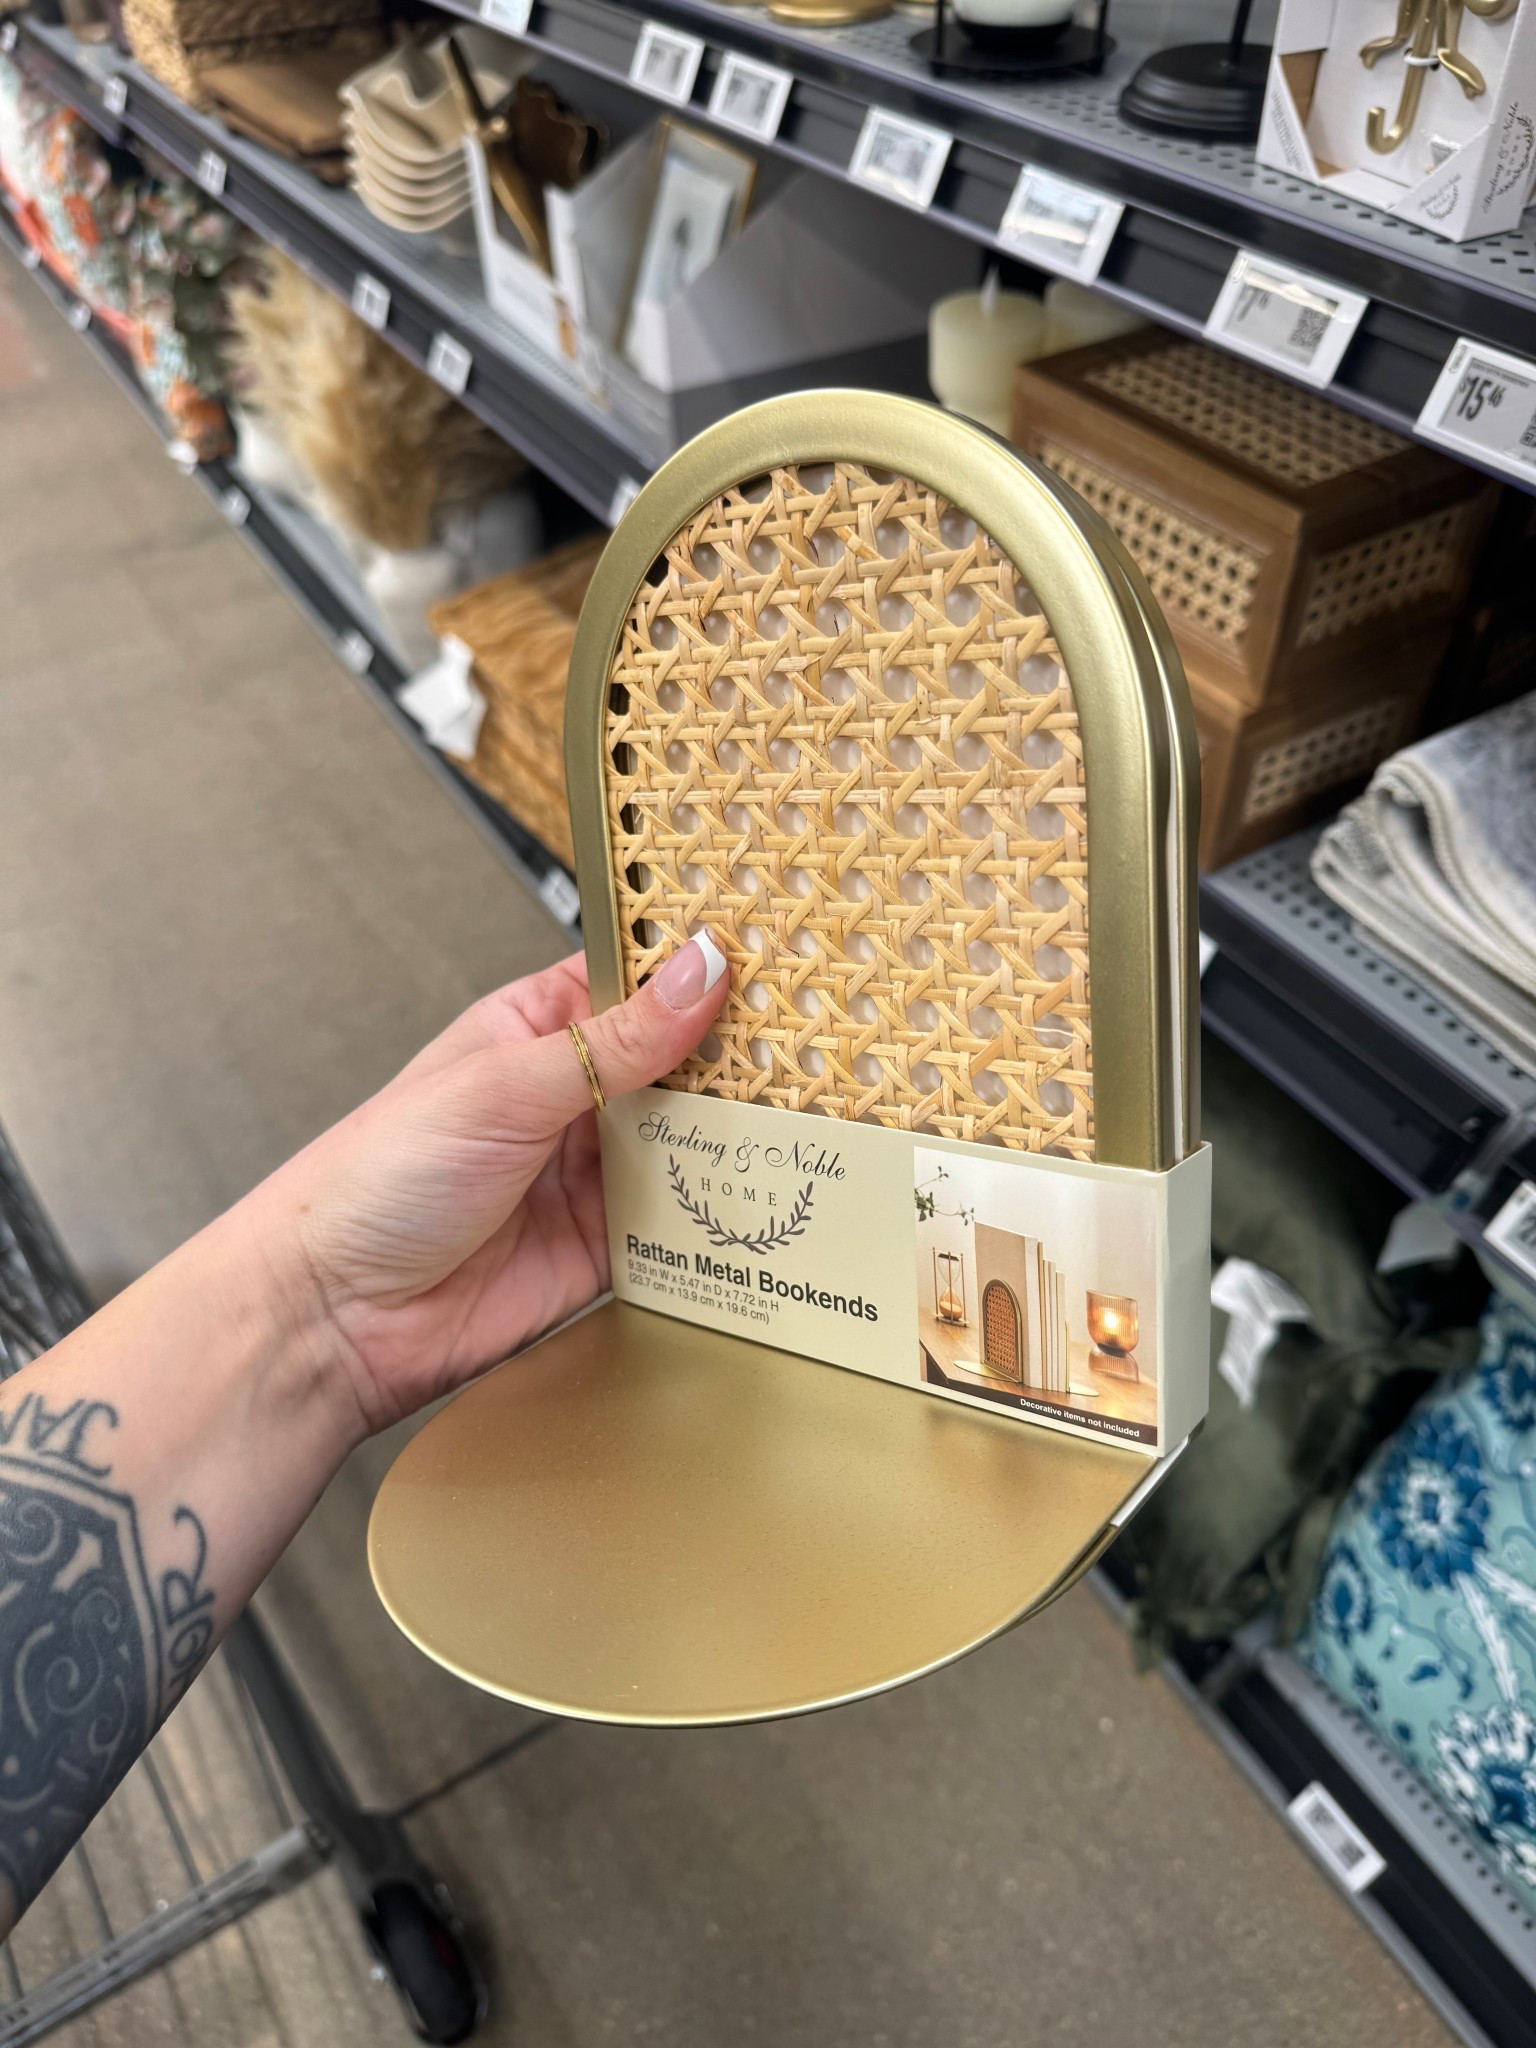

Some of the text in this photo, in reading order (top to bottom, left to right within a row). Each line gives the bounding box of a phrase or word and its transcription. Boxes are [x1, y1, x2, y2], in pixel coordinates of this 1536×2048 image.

[638, 1111, 846, 1181] Sterling & Noble
[701, 1177, 777, 1207] HOME
[627, 1234, 879, 1322] Rattan Metal Bookends
[628, 1258, 779, 1312] 9.33 in W x 5.47 in D x 7.72 in H
[629, 1271, 770, 1325] (23.7 cm x 13.9 cm x 19.6 cm)
[1020, 1398, 1062, 1416] Decorative
[1063, 1410, 1086, 1423] items
[1087, 1416, 1102, 1428] not
